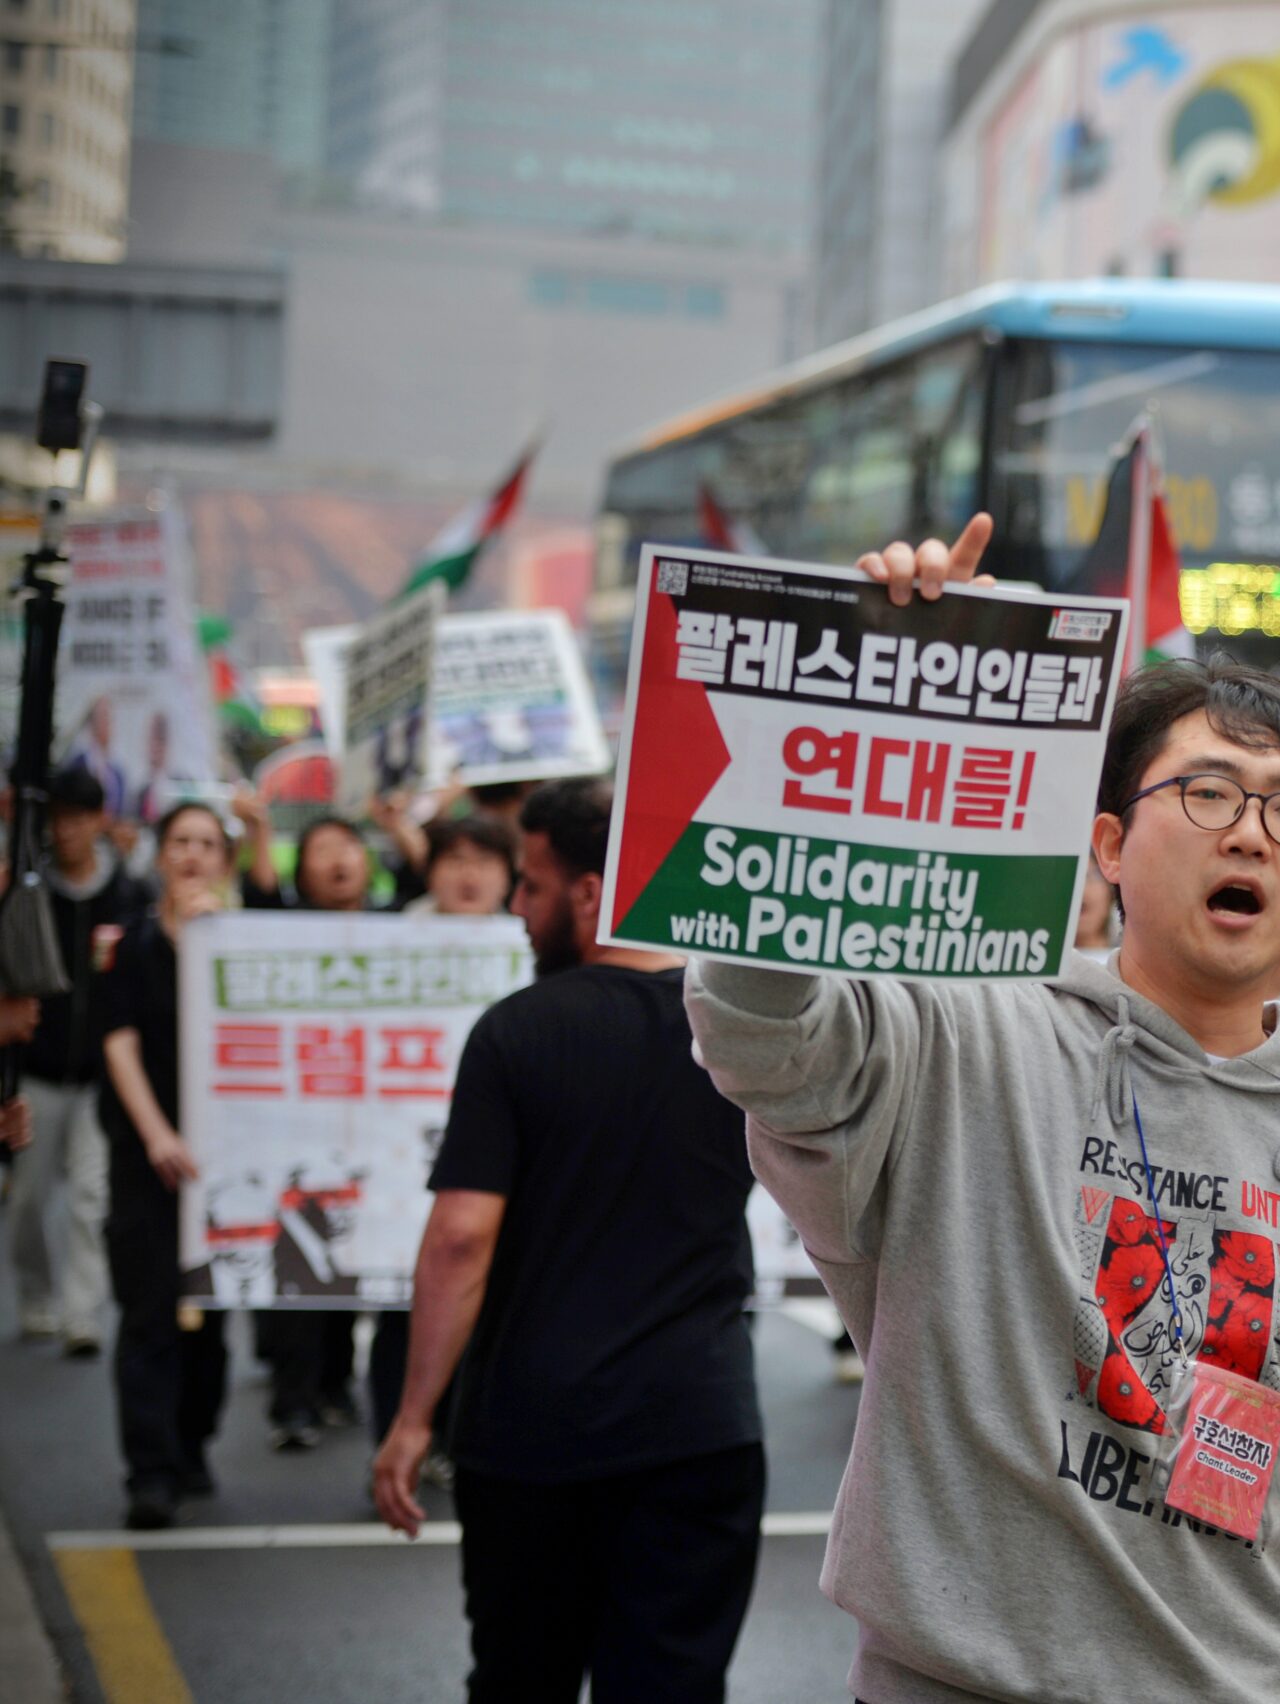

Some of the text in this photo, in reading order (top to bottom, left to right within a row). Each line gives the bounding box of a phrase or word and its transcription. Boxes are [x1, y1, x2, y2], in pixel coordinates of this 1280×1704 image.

[675, 608, 1103, 722] 팔레스타인인들과
[781, 725, 1037, 831] 연대를!
[700, 827, 979, 927] Solidarity
[670, 896, 1050, 974] with Palestinians
[1079, 1136, 1229, 1212] RESTANCE
[1194, 1415, 1271, 1468] 구호선창자
[1197, 1451, 1257, 1484] Chant Leader
